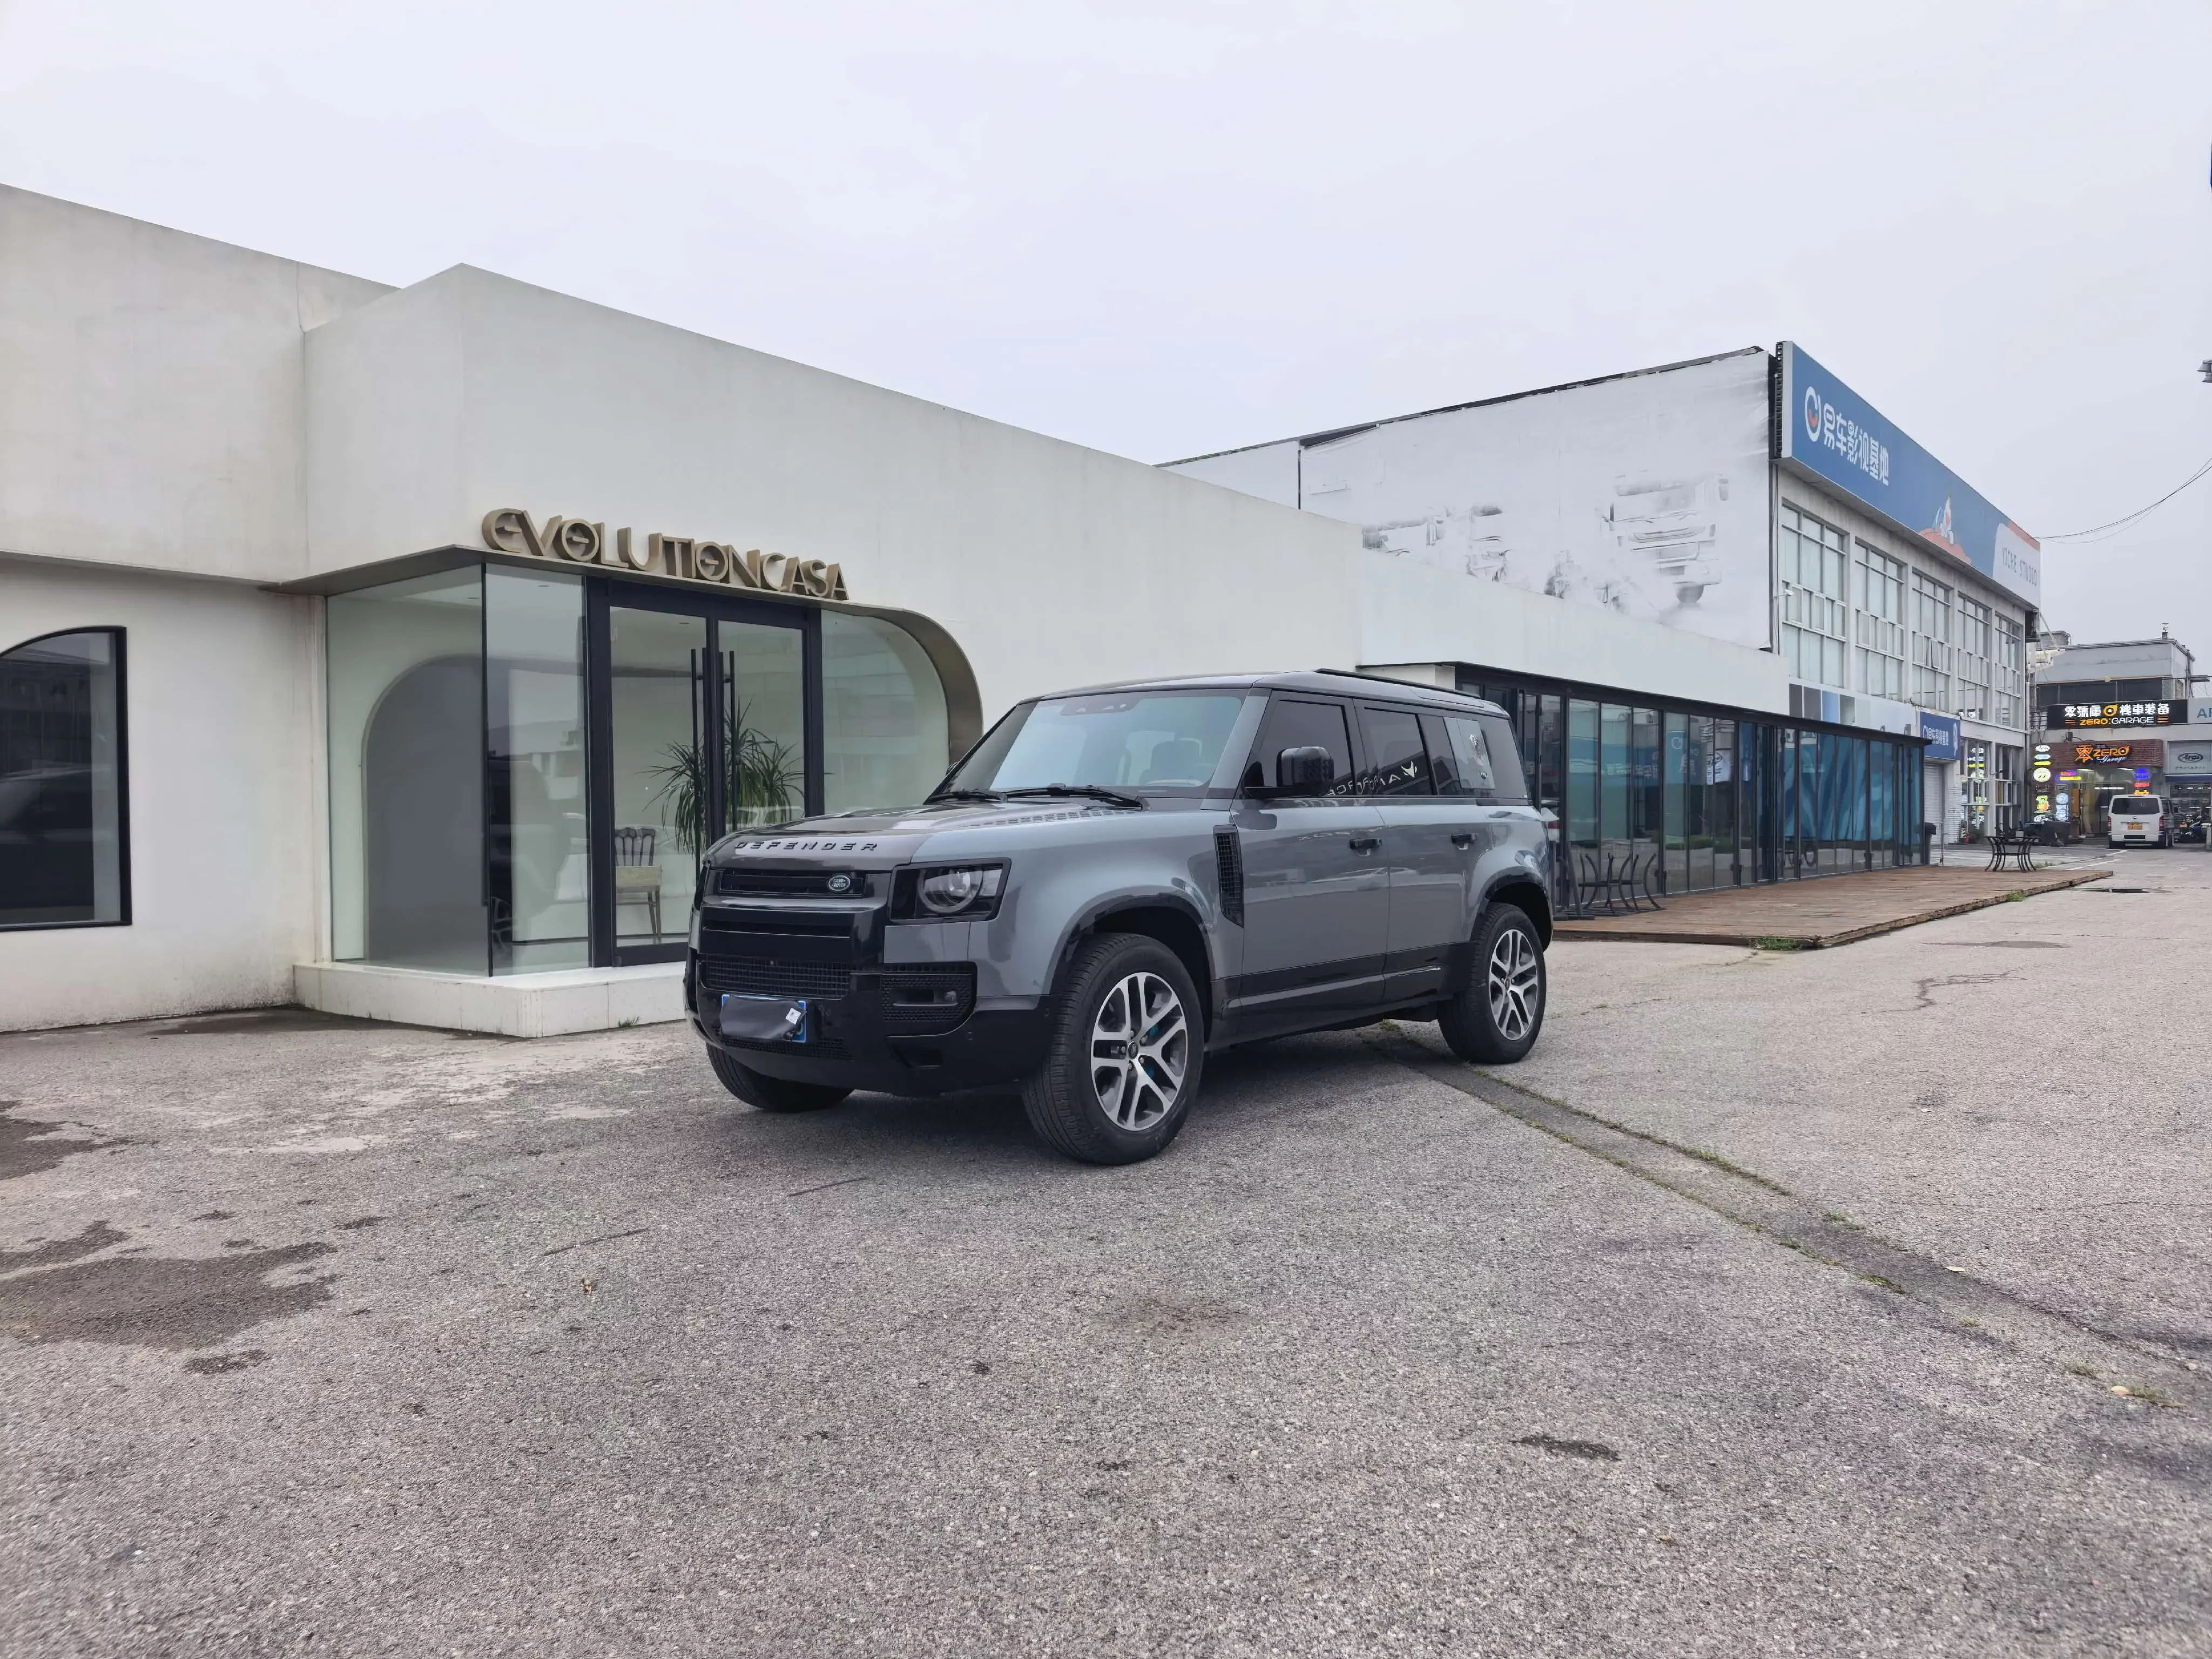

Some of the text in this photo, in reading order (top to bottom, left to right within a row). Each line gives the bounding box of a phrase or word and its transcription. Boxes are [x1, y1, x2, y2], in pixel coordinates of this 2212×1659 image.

[1823, 402, 1889, 486] 易车影视基地
[481, 508, 850, 601] EVOLUTIONCASA
[2001, 545, 2037, 586] YICHE STUDIO
[734, 841, 878, 851] DEFENDER
